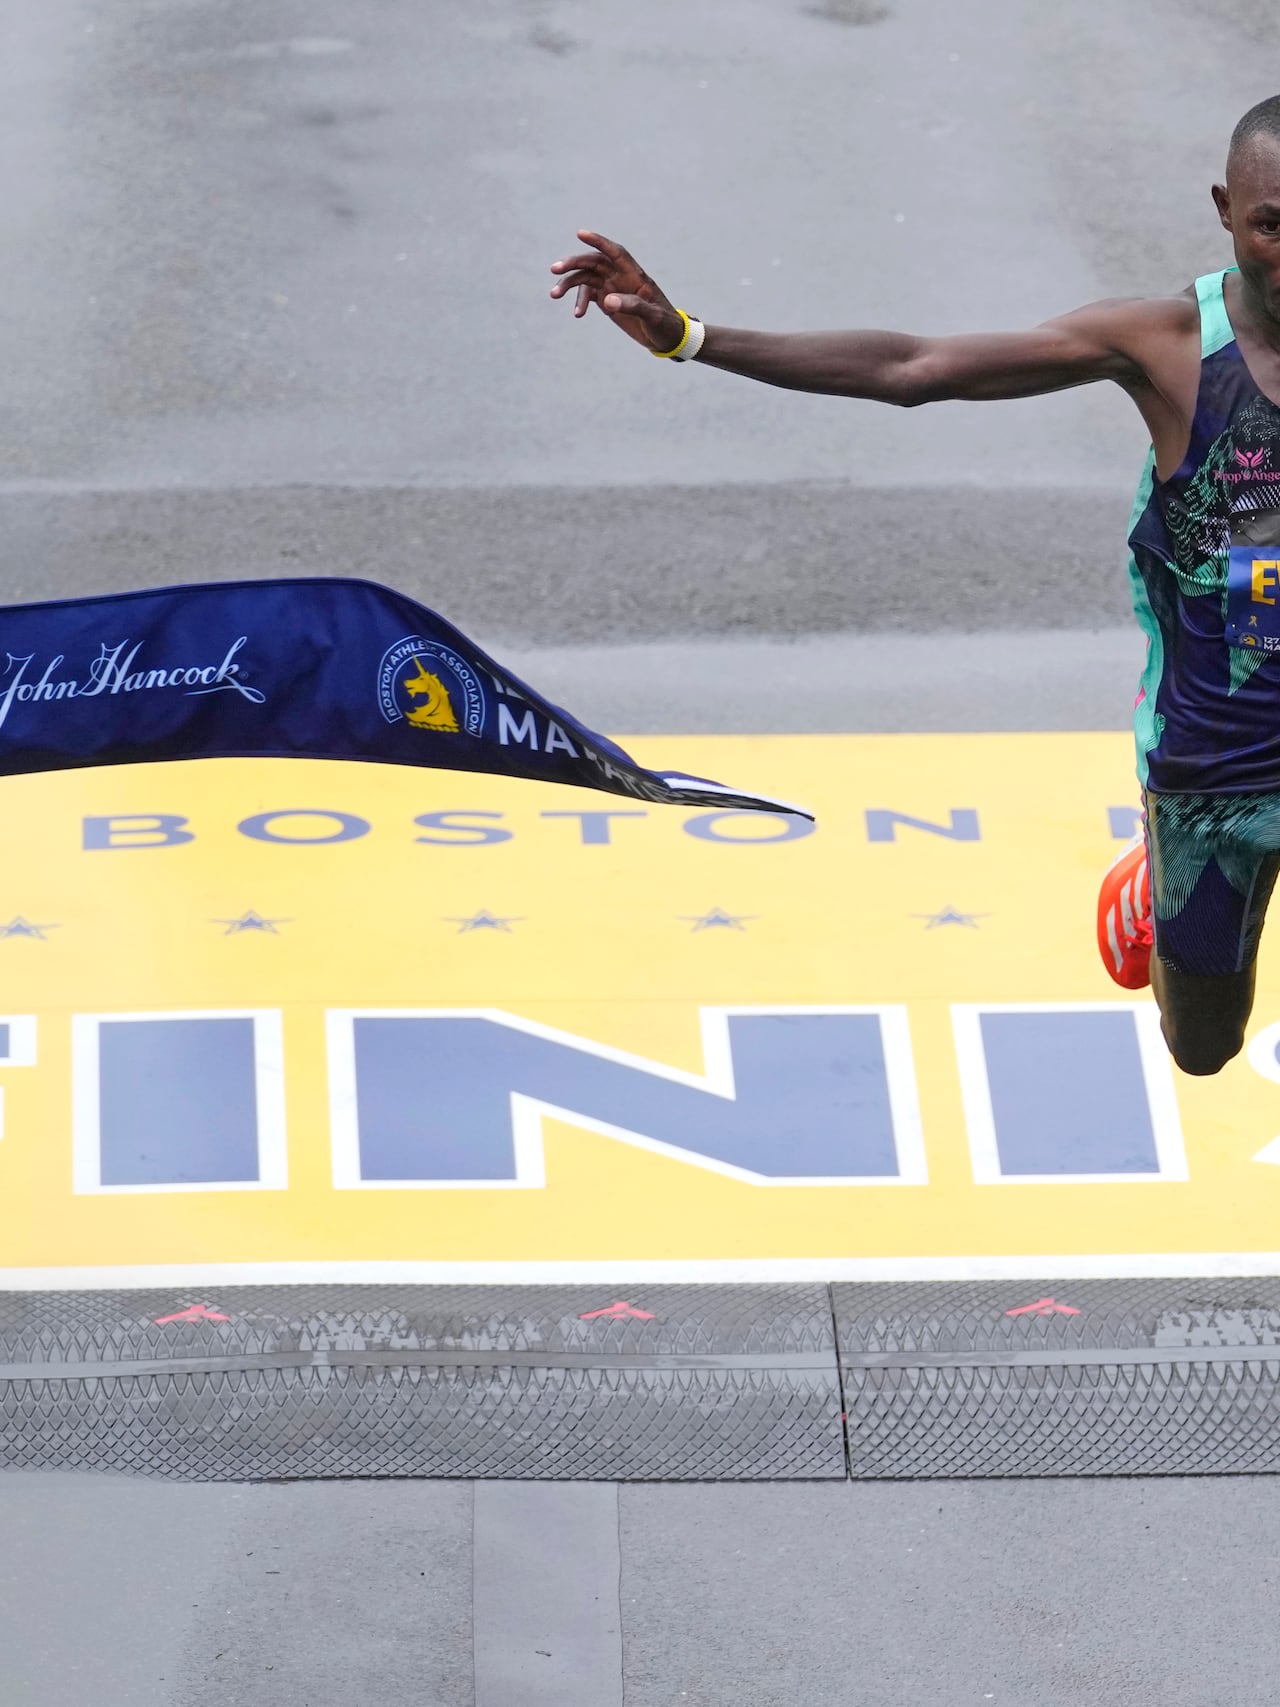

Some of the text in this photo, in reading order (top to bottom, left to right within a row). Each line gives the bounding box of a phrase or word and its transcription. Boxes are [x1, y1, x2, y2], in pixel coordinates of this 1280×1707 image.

[0, 636, 266, 729] John Hancock
[382, 664, 397, 717] BOSTON
[440, 651, 480, 733] ASSOCIATION
[82, 808, 982, 851] BOSTON
